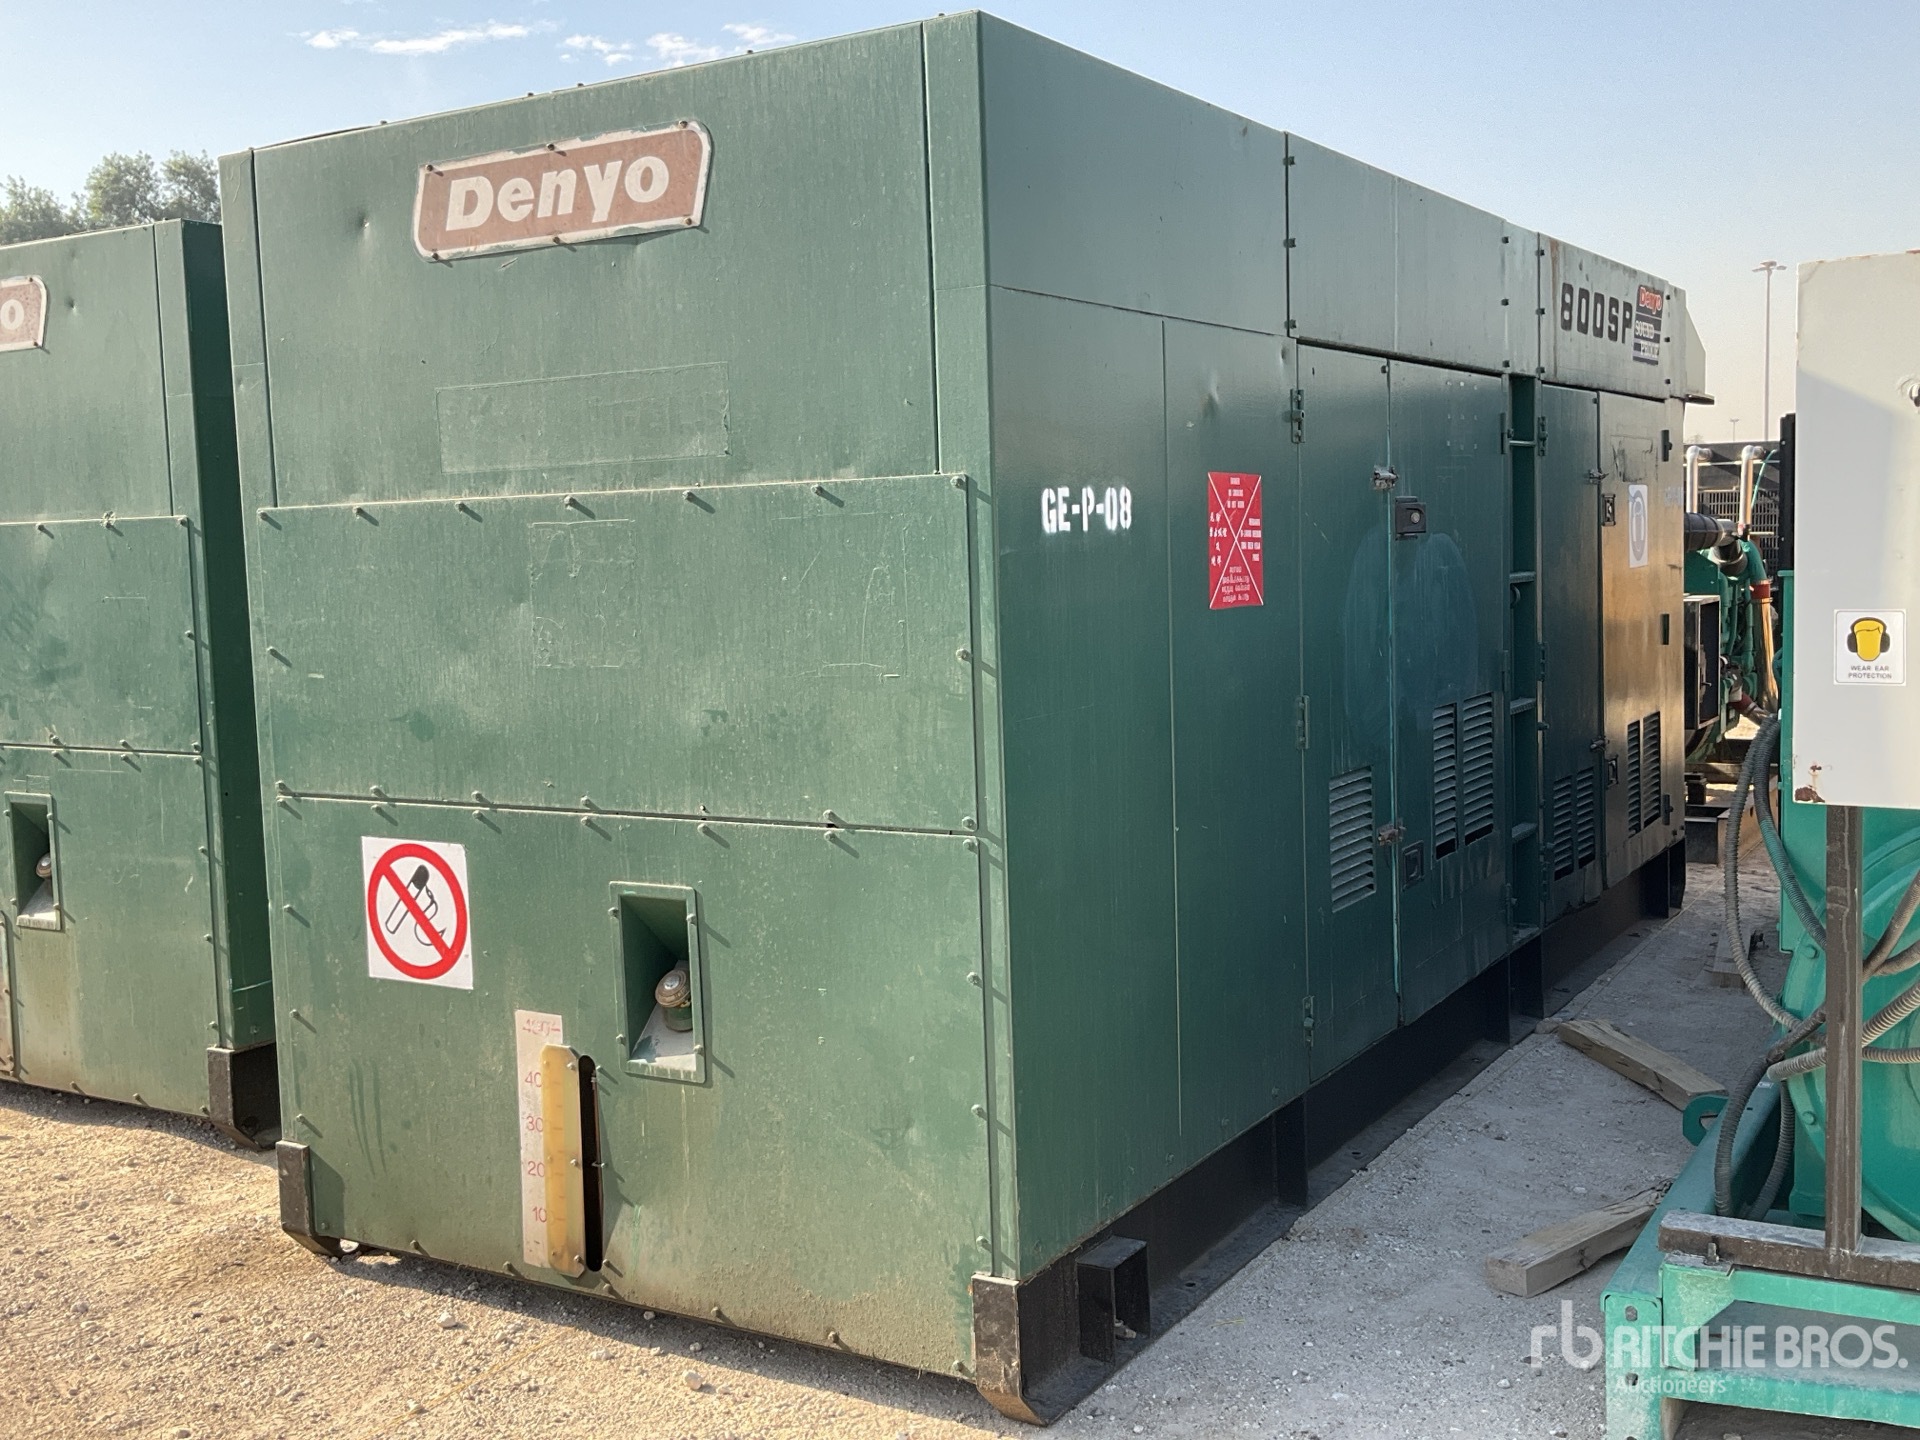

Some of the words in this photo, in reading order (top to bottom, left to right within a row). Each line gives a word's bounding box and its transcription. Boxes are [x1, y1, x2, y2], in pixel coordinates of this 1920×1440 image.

[446, 156, 669, 231] Denyo
[1561, 282, 1633, 344] 800SP
[1042, 486, 1132, 533] GE-P-08
[525, 1071, 542, 1088] 40
[526, 1115, 544, 1132] 30
[527, 1160, 545, 1178] 20
[532, 1206, 548, 1223] 10
